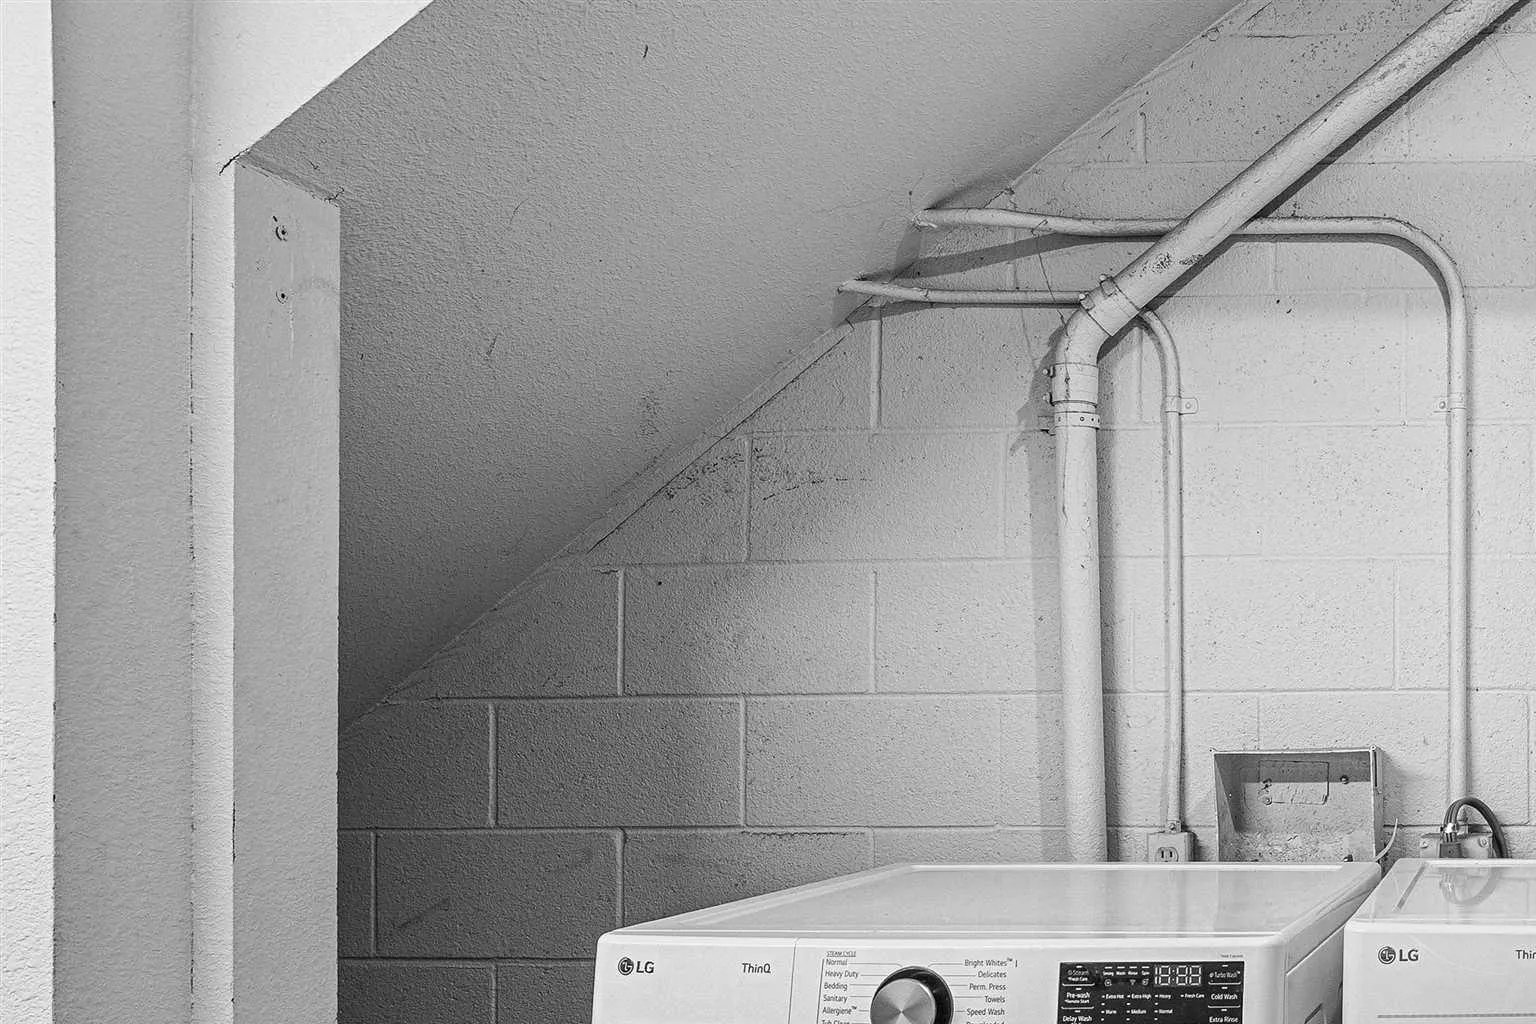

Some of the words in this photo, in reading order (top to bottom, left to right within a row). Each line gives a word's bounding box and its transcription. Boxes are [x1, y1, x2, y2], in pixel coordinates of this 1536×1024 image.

[1399, 949, 1419, 962] LG
[825, 958, 848, 966] Normal
[964, 959, 984, 968] Bright
[636, 961, 655, 974] LG
[742, 962, 772, 974] ThinQ
[825, 970, 846, 979] Heavy
[846, 970, 859, 979] Duty
[978, 971, 1007, 979] Delicates
[824, 982, 848, 991] Bedding
[988, 983, 1006, 991] Press
[823, 994, 848, 1003] Sanitary
[984, 995, 1006, 1003] Towels
[966, 1008, 987, 1017] Speed
